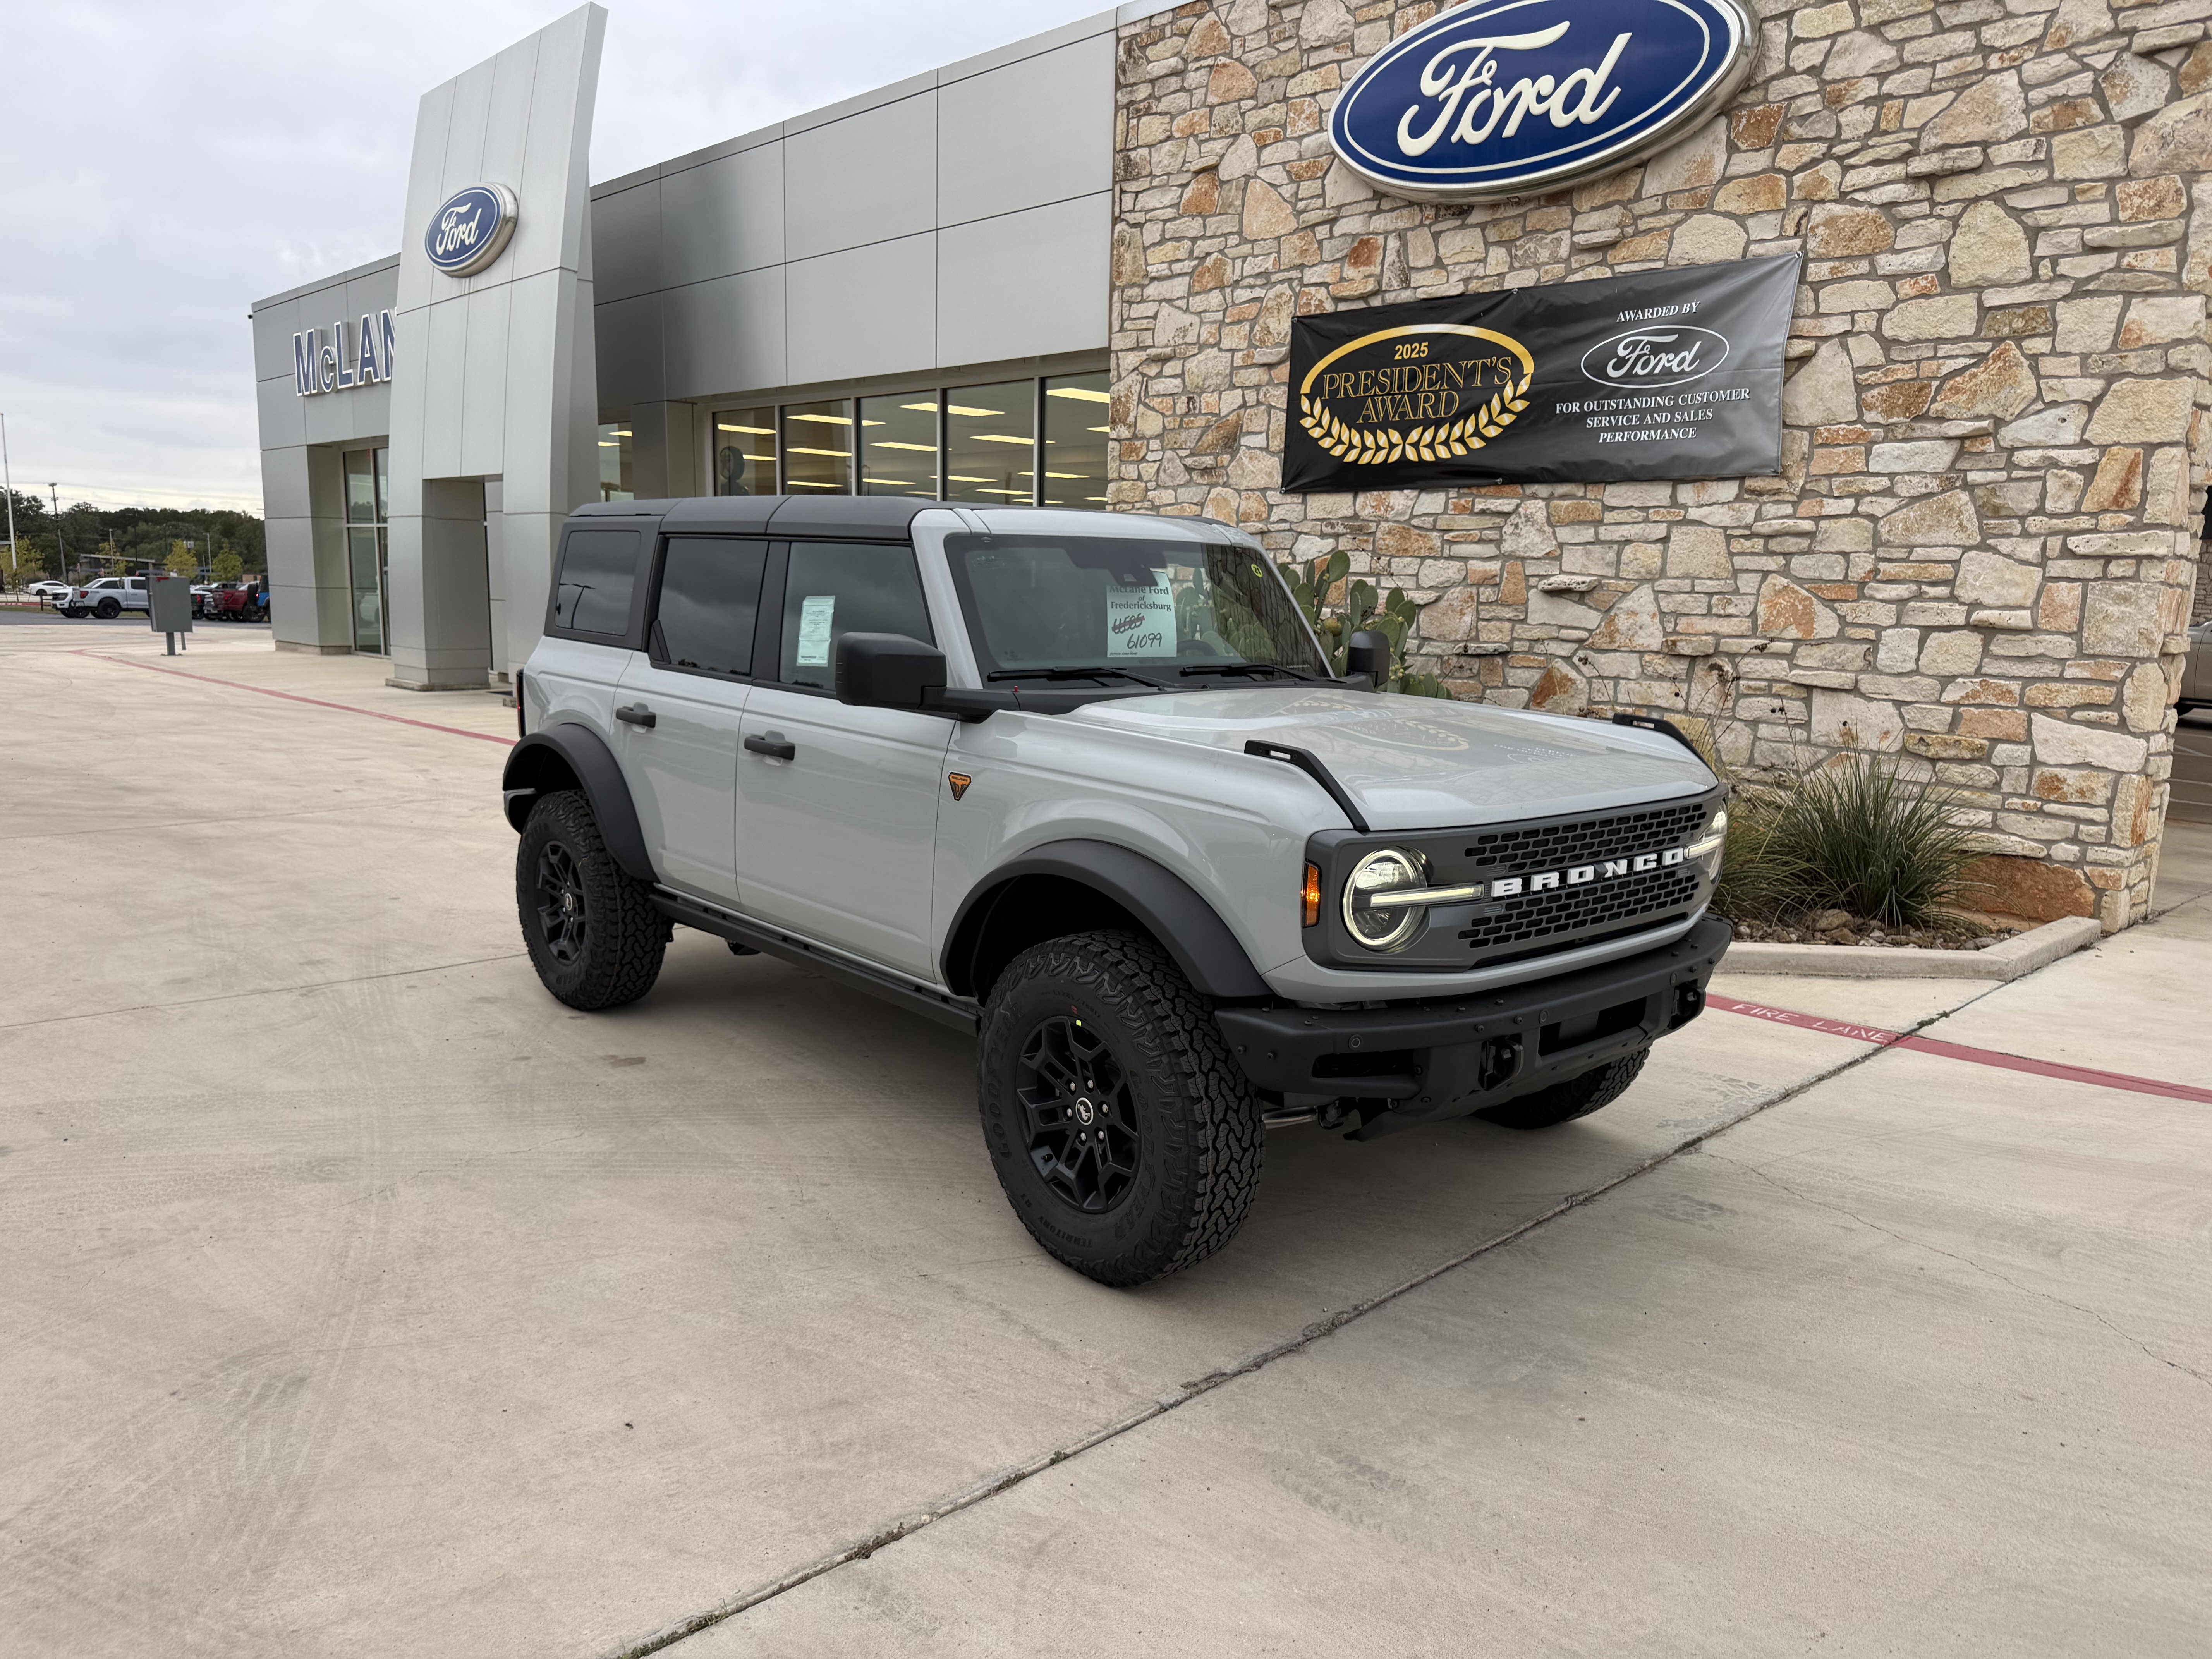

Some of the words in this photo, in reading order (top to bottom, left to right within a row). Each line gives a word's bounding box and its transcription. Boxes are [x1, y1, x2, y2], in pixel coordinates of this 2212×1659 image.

[1397, 21, 1632, 157] Ford
[436, 203, 482, 256] Ford
[1616, 305, 1679, 322] AWARDED
[1681, 300, 1700, 314] BY
[1394, 342, 1429, 360] 2025
[1607, 333, 1702, 378] Ford
[1321, 356, 1511, 400] PRESIDENT'S
[1356, 390, 1459, 424] AWARD
[1555, 402, 1580, 414] FOR
[1583, 395, 1674, 412] OUTSTANDING
[1678, 388, 1751, 406] CUSTOMER
[1586, 414, 1640, 428] SERVICE
[1644, 412, 1671, 425] AND
[1674, 409, 1713, 423] SALES
[1598, 427, 1697, 443] PERFORMANCE
[1253, 566, 1261, 575] 21
[1110, 586, 1146, 594] McLane
[1149, 586, 1169, 595] Ford
[1111, 601, 1171, 612] Fredericksburg
[1127, 632, 1163, 649] 61099
[1491, 847, 1684, 898] BRONCO
[1732, 1003, 1800, 1022] FIRE
[1812, 1021, 1896, 1042] LANE
[988, 1002, 1025, 1160] GOODYEAR
[1114, 1070, 1156, 1242] GOODYEAR
[1038, 1215, 1092, 1248] TERRITORY
